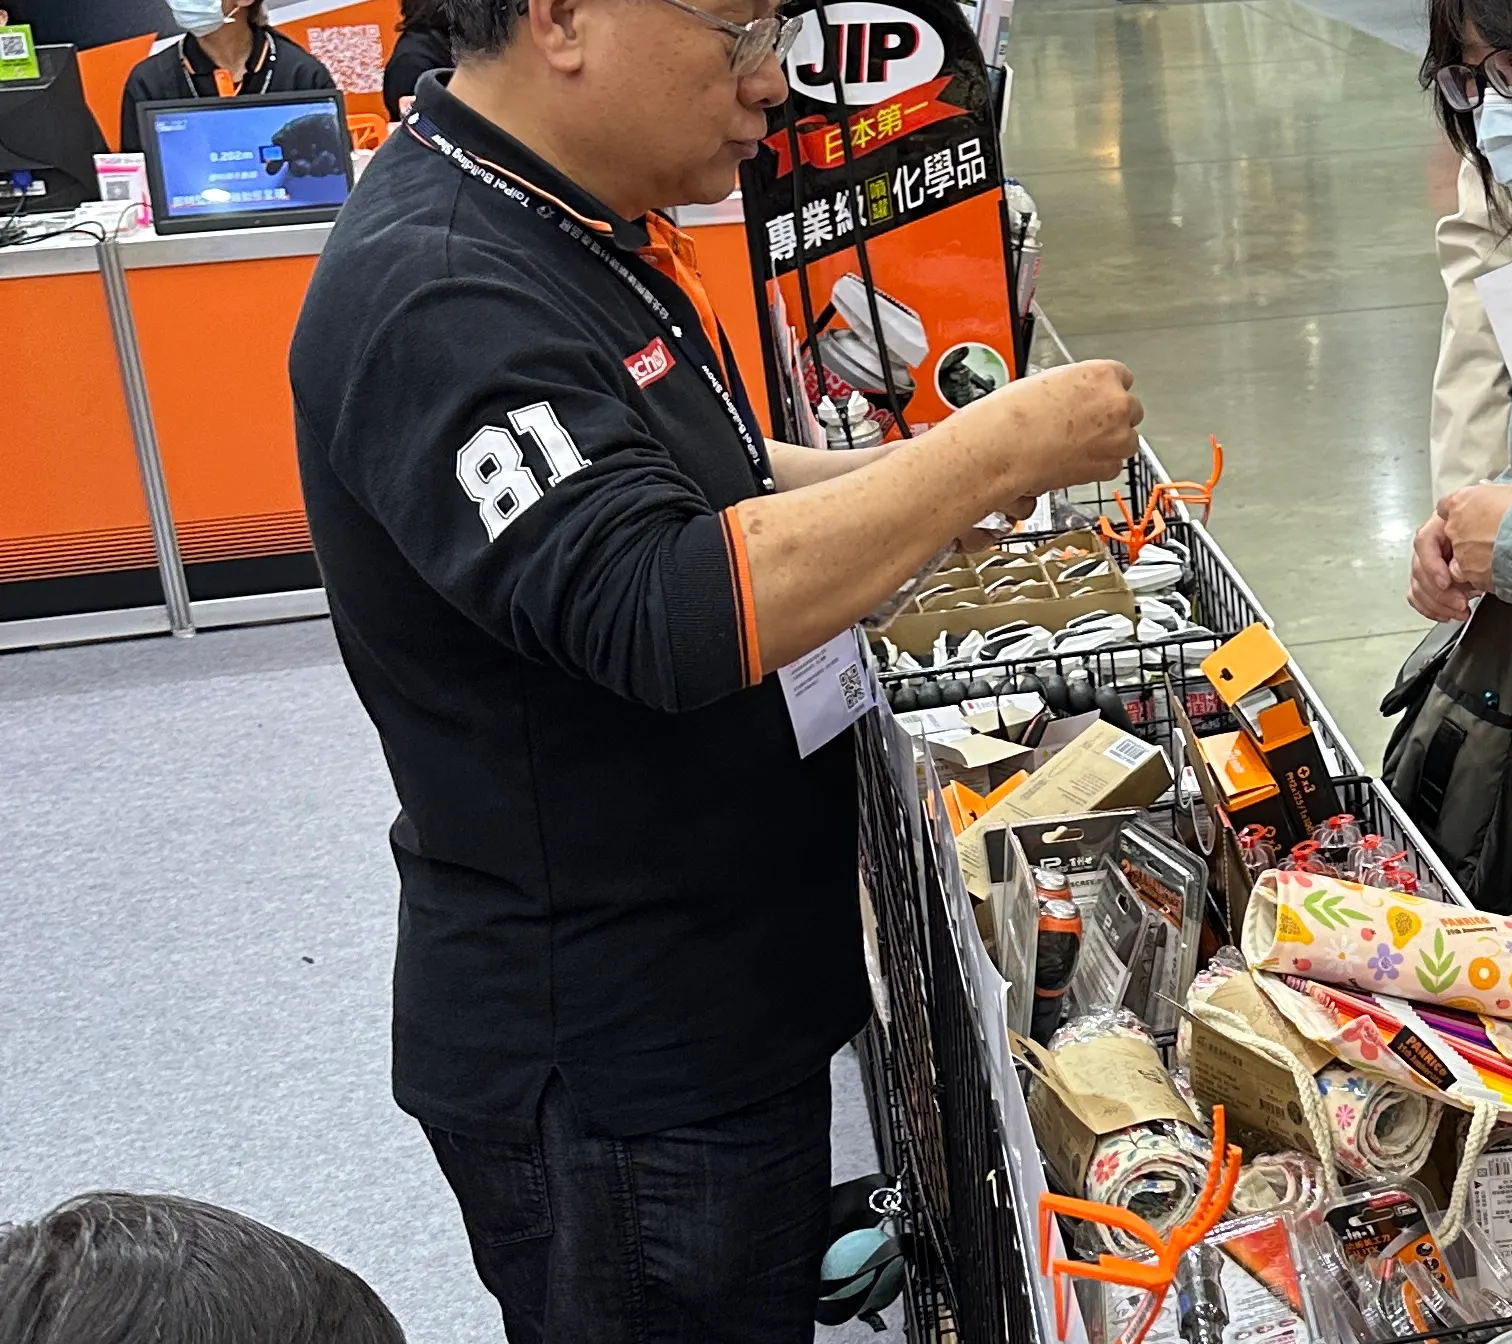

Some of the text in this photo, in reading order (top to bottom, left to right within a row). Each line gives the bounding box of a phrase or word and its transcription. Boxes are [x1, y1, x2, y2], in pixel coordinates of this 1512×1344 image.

[796, 22, 921, 86] JIP
[825, 102, 929, 164] 日本第一
[456, 401, 592, 544] 81
[1406, 1035, 1448, 1077] PANRICO
